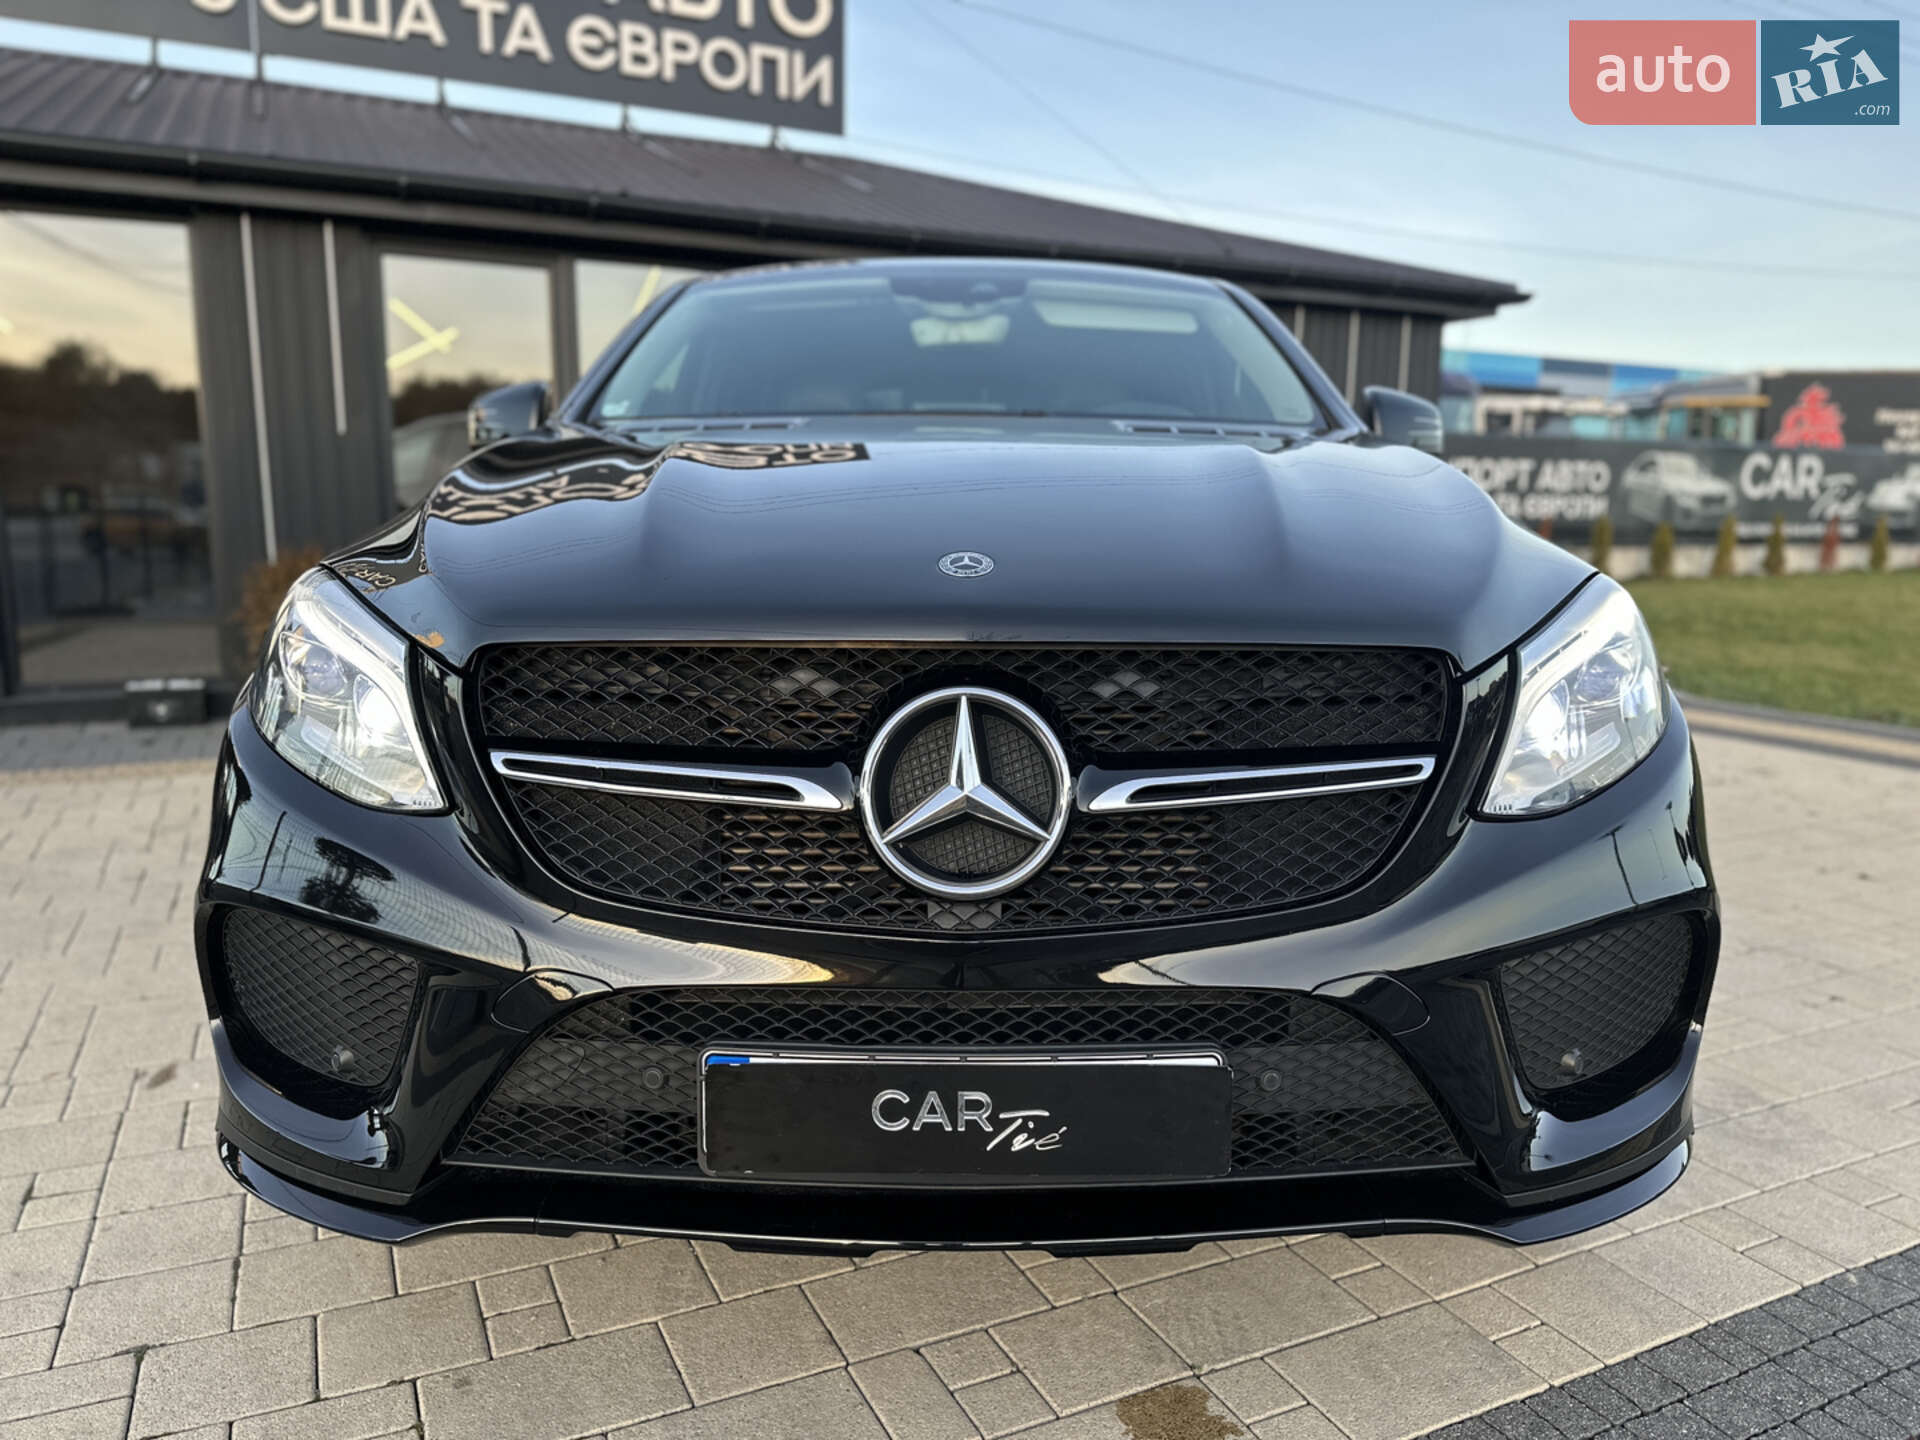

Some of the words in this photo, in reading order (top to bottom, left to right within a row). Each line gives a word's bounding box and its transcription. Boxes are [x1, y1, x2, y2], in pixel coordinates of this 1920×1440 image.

[460, 0, 553, 63] ТА
[565, 14, 834, 107] ЄВРОПИ
[1535, 459, 1611, 492] АВТО
[1740, 451, 1824, 500] CAR
[871, 1089, 994, 1132] CAR
